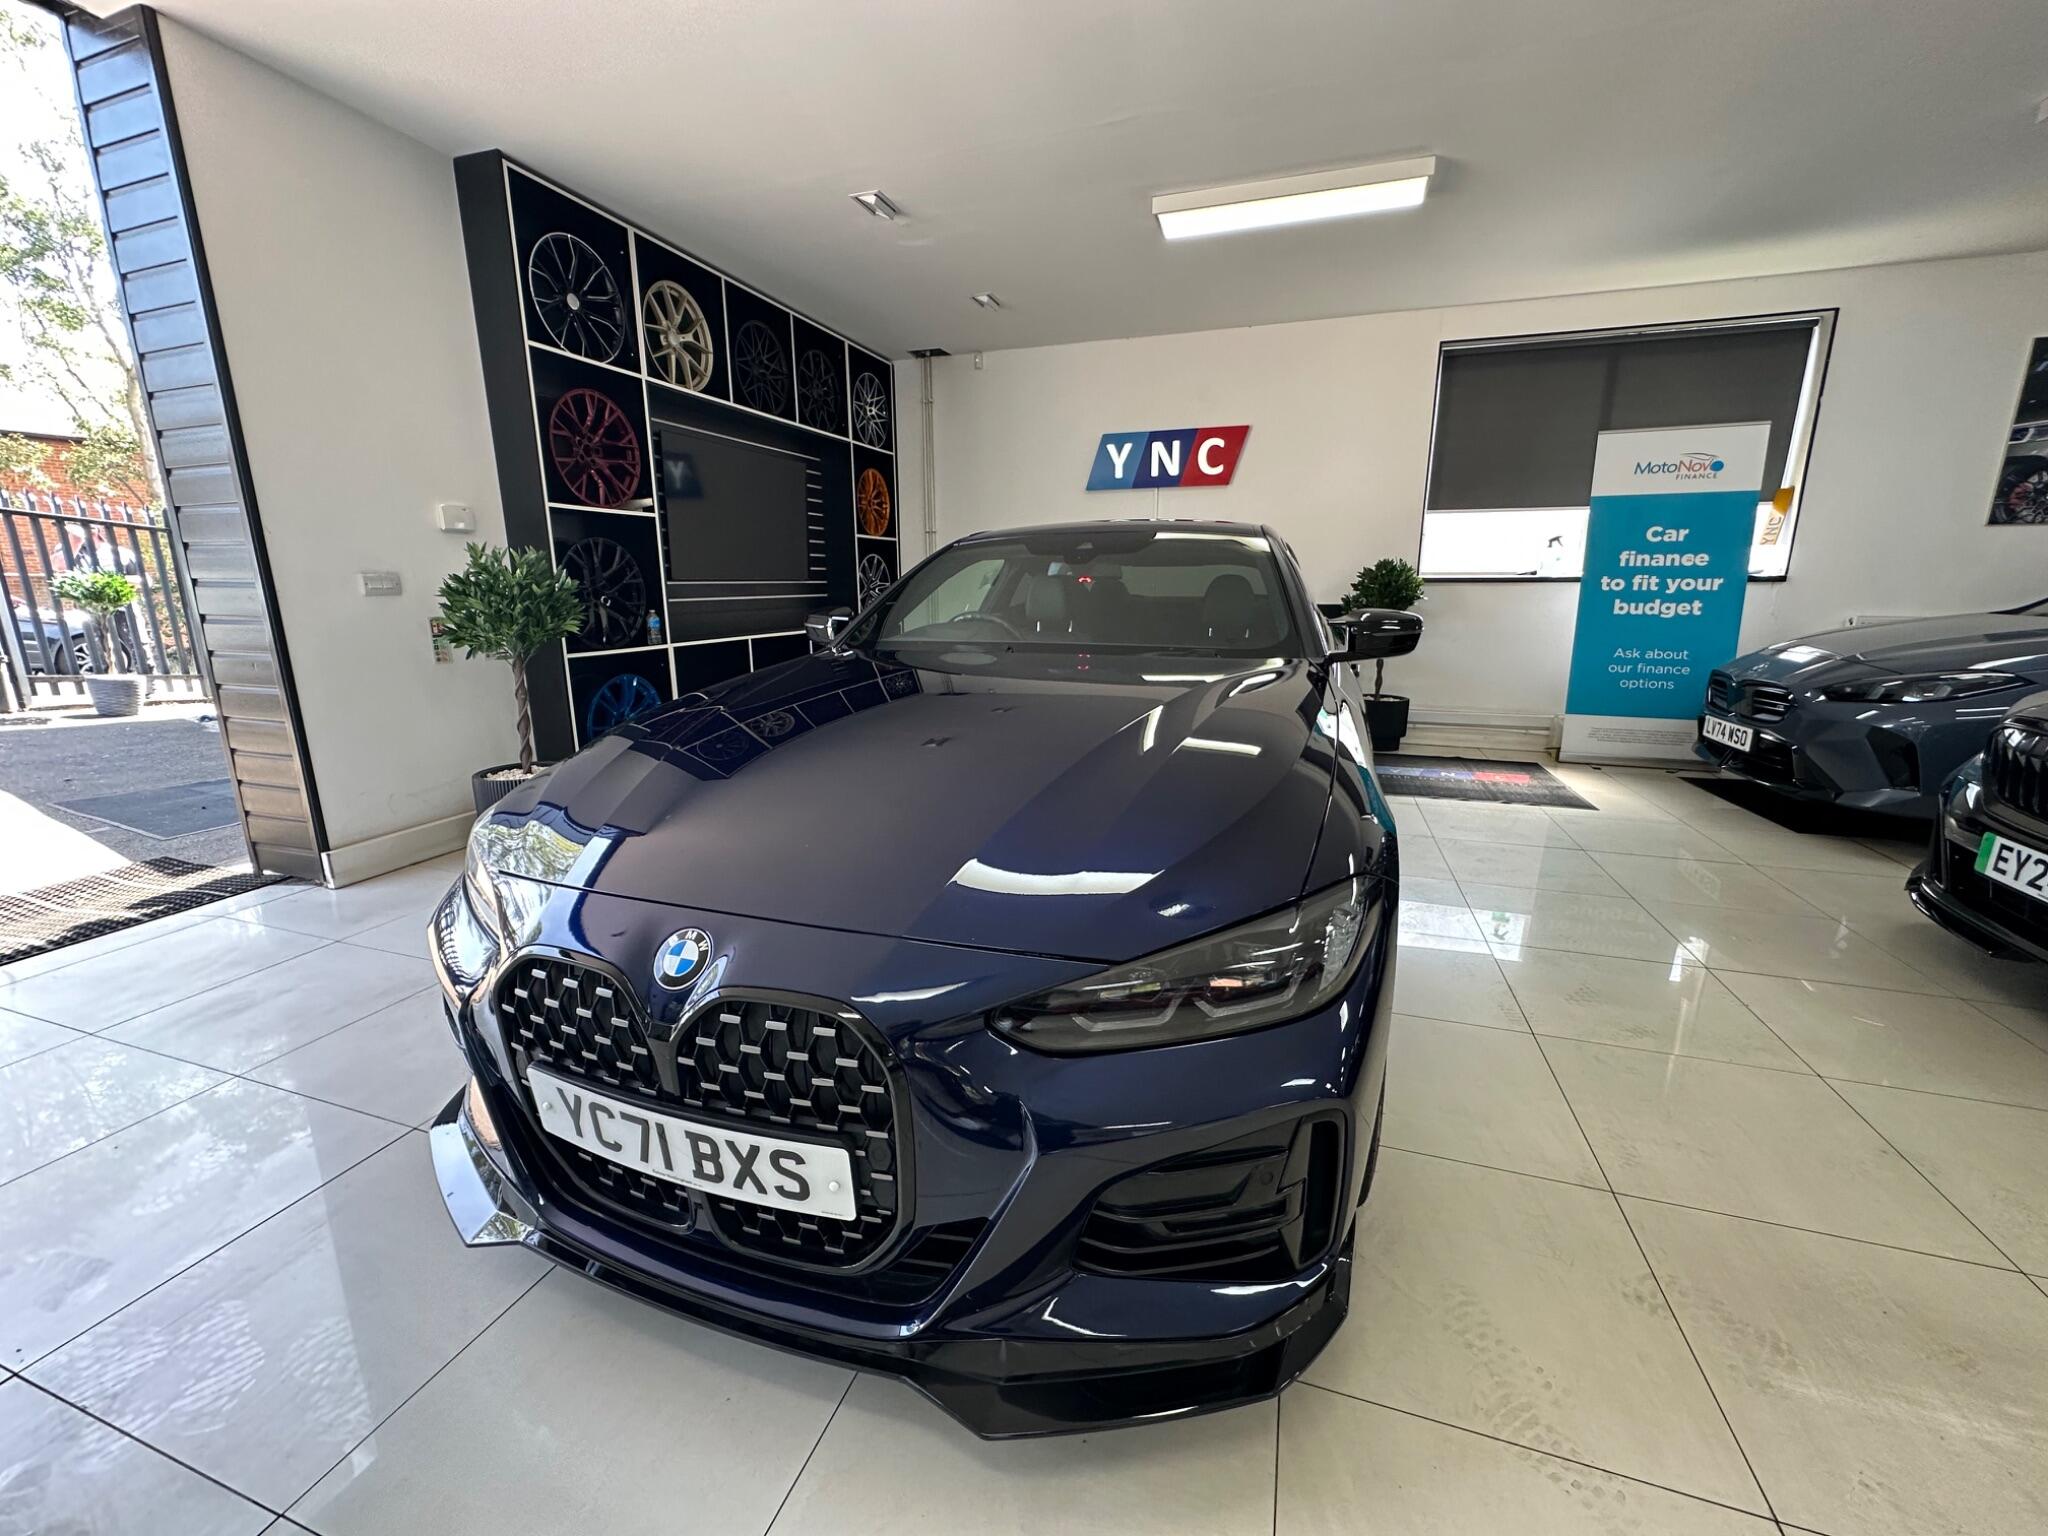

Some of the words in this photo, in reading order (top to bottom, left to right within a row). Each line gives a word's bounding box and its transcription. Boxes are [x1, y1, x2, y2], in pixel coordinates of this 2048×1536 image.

[1106, 437, 1225, 479] YNC
[1676, 472, 1717, 481] FINANCE
[1645, 526, 1690, 542] Car
[1619, 550, 1710, 567] finance
[1600, 575, 1626, 591] to
[1632, 574, 1660, 591] fit
[1665, 577, 1724, 594] your
[1613, 598, 1703, 618] budget
[1613, 647, 1641, 659] Ask
[1645, 648, 1689, 660] about
[1608, 664, 1633, 673] our
[1637, 662, 1691, 675] finance
[1619, 679, 1675, 690] options
[1992, 843, 2048, 892] EY2
[555, 1087, 674, 1172] YC71
[685, 1129, 811, 1201] BXS
